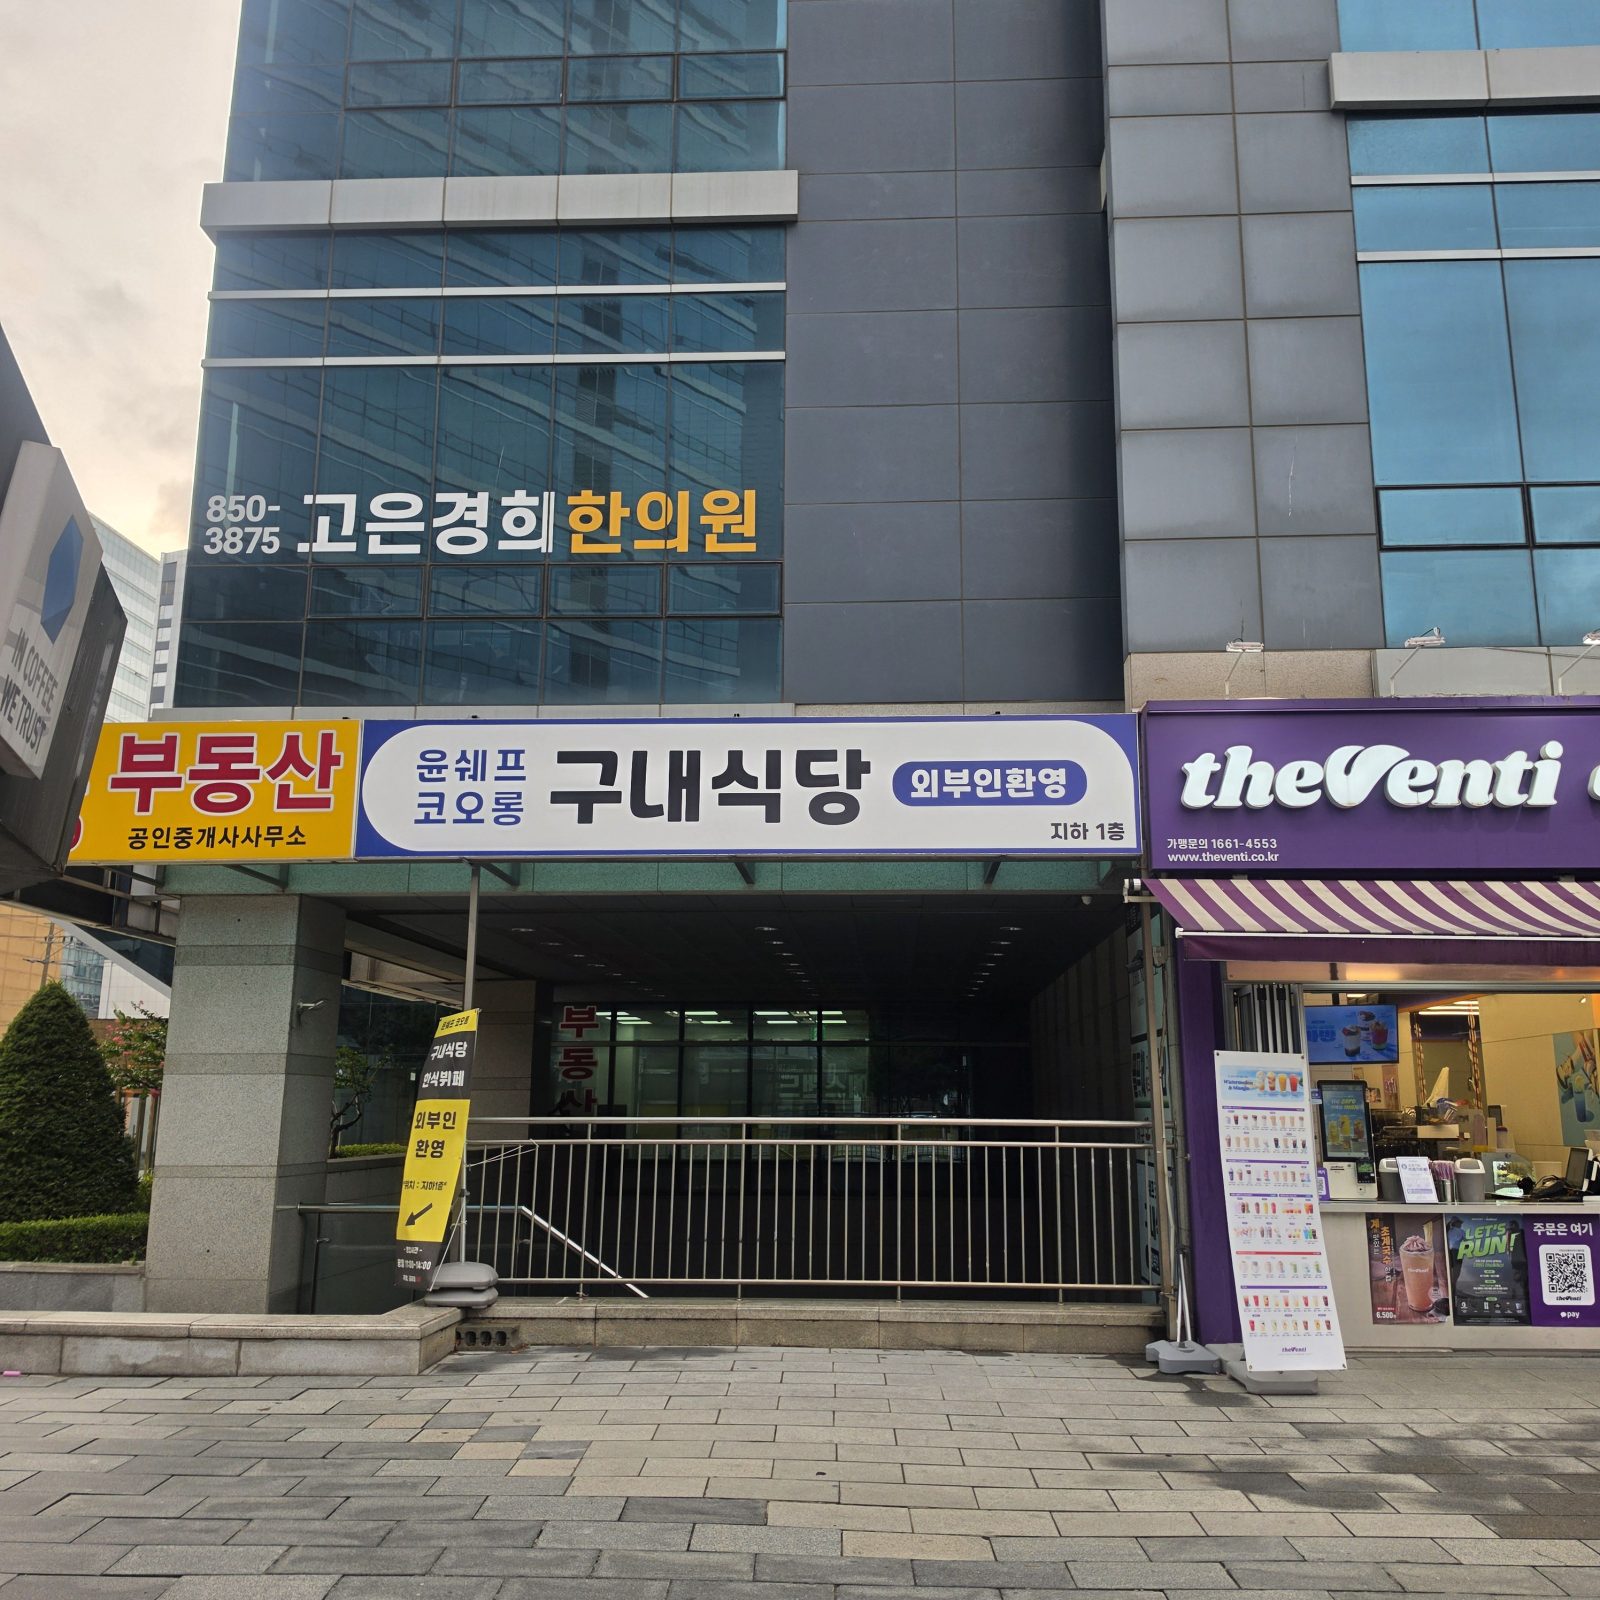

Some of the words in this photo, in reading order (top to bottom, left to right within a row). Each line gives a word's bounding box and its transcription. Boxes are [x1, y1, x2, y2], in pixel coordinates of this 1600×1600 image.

[206, 495, 280, 523] 850-
[203, 526, 280, 554] 3875
[11, 627, 29, 672] IN
[23, 645, 59, 713] COFFEE
[15, 694, 47, 755] TRUST
[109, 730, 343, 816] 부동산
[417, 749, 526, 783] 윤쉐프
[1181, 740, 1564, 809] theVenti
[549, 748, 871, 826] 구내식당
[909, 767, 1068, 799] 외부인환영
[414, 791, 524, 827] 코오롱
[127, 826, 306, 850] 공인중개사사무소
[1050, 821, 1090, 841] 지하
[1096, 820, 1126, 841] 1층
[1167, 838, 1208, 850] 가맹문의
[1210, 838, 1278, 849] 1661-4553
[1167, 852, 1280, 863] www.theventi.co.kr
[430, 1041, 468, 1060] 구내식당
[414, 1110, 457, 1131] 외부인
[415, 1139, 446, 1159] 환영
[1465, 1222, 1507, 1240] LET'S
[1532, 1222, 1568, 1236] 주문은
[1570, 1222, 1593, 1236] 여기
[1457, 1232, 1520, 1260] RUN!
[1567, 1311, 1580, 1319] pay
